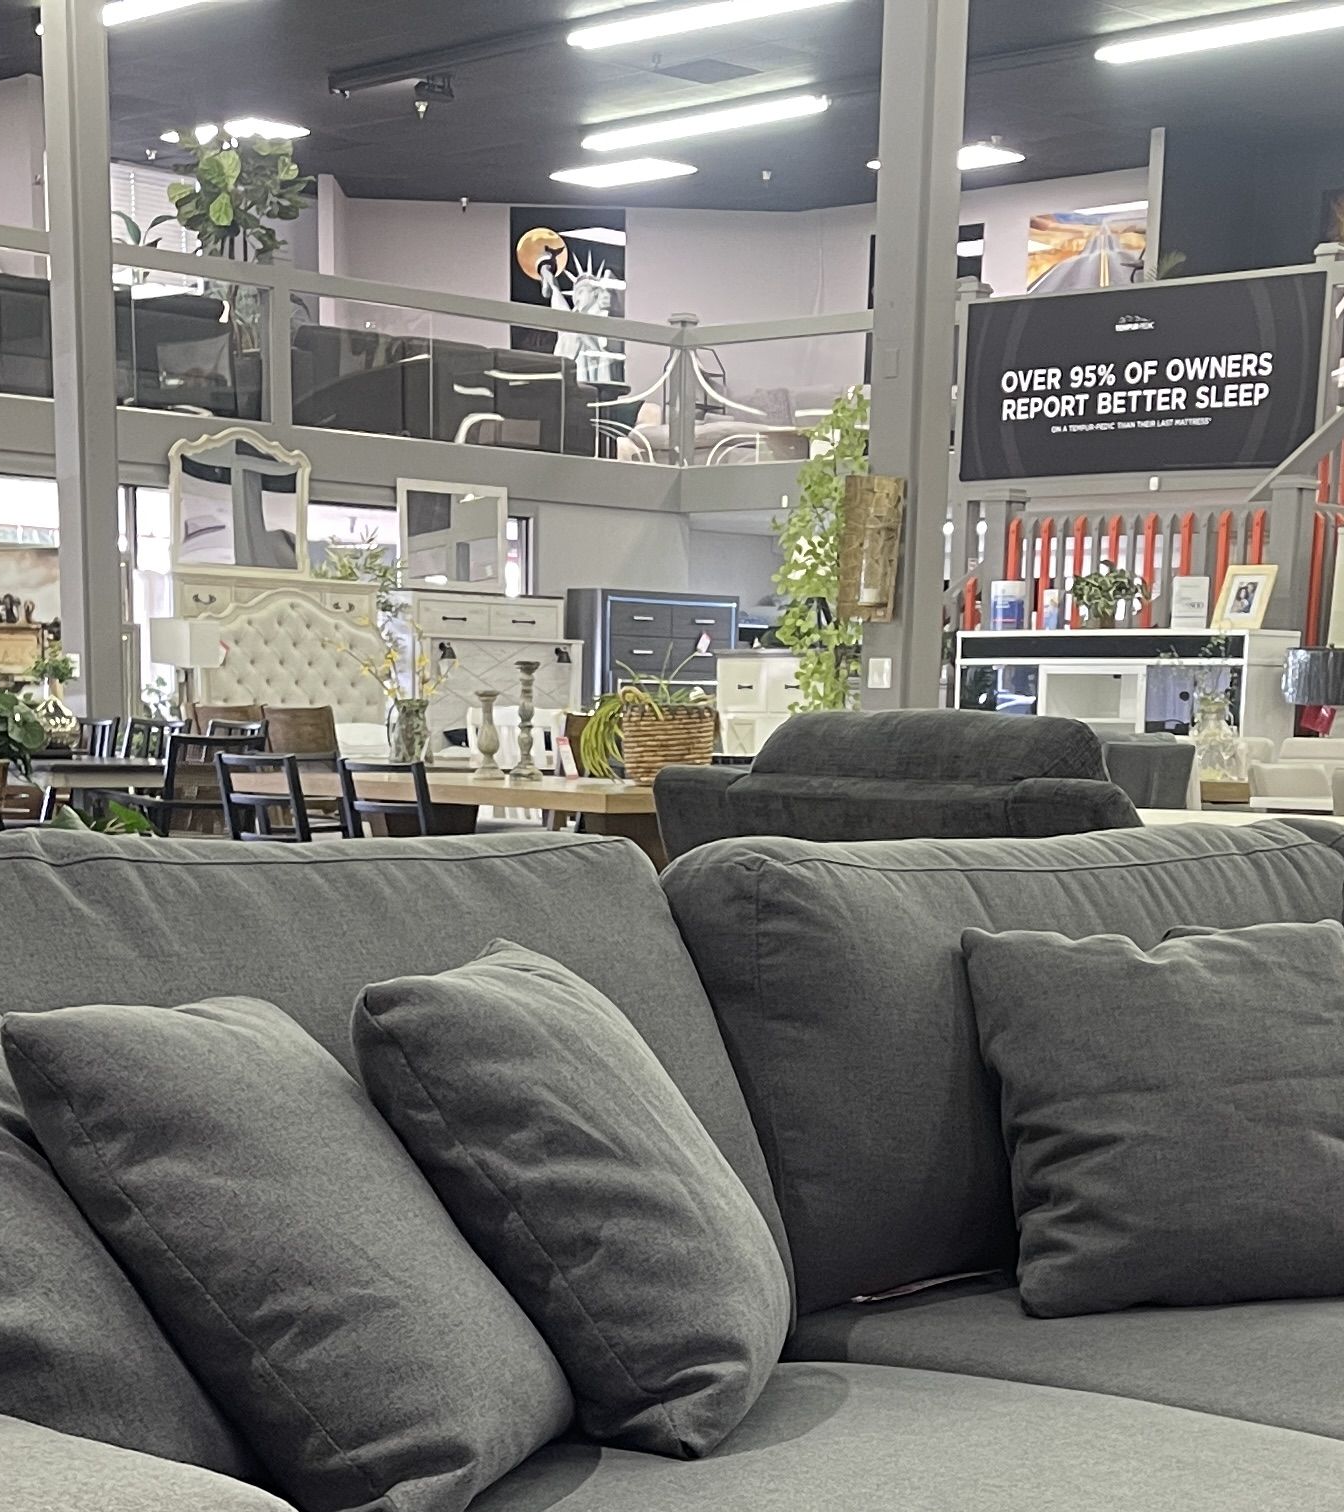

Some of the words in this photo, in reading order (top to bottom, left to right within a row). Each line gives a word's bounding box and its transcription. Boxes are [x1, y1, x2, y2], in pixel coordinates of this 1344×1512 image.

[1001, 368, 1062, 393] OVER
[1070, 363, 1116, 388] 95%
[1124, 360, 1158, 384] OF
[1165, 352, 1273, 382] OWNERS
[1001, 393, 1089, 421] REPORT
[1096, 387, 1187, 415] BETTER
[1195, 382, 1270, 409] SLEEP
